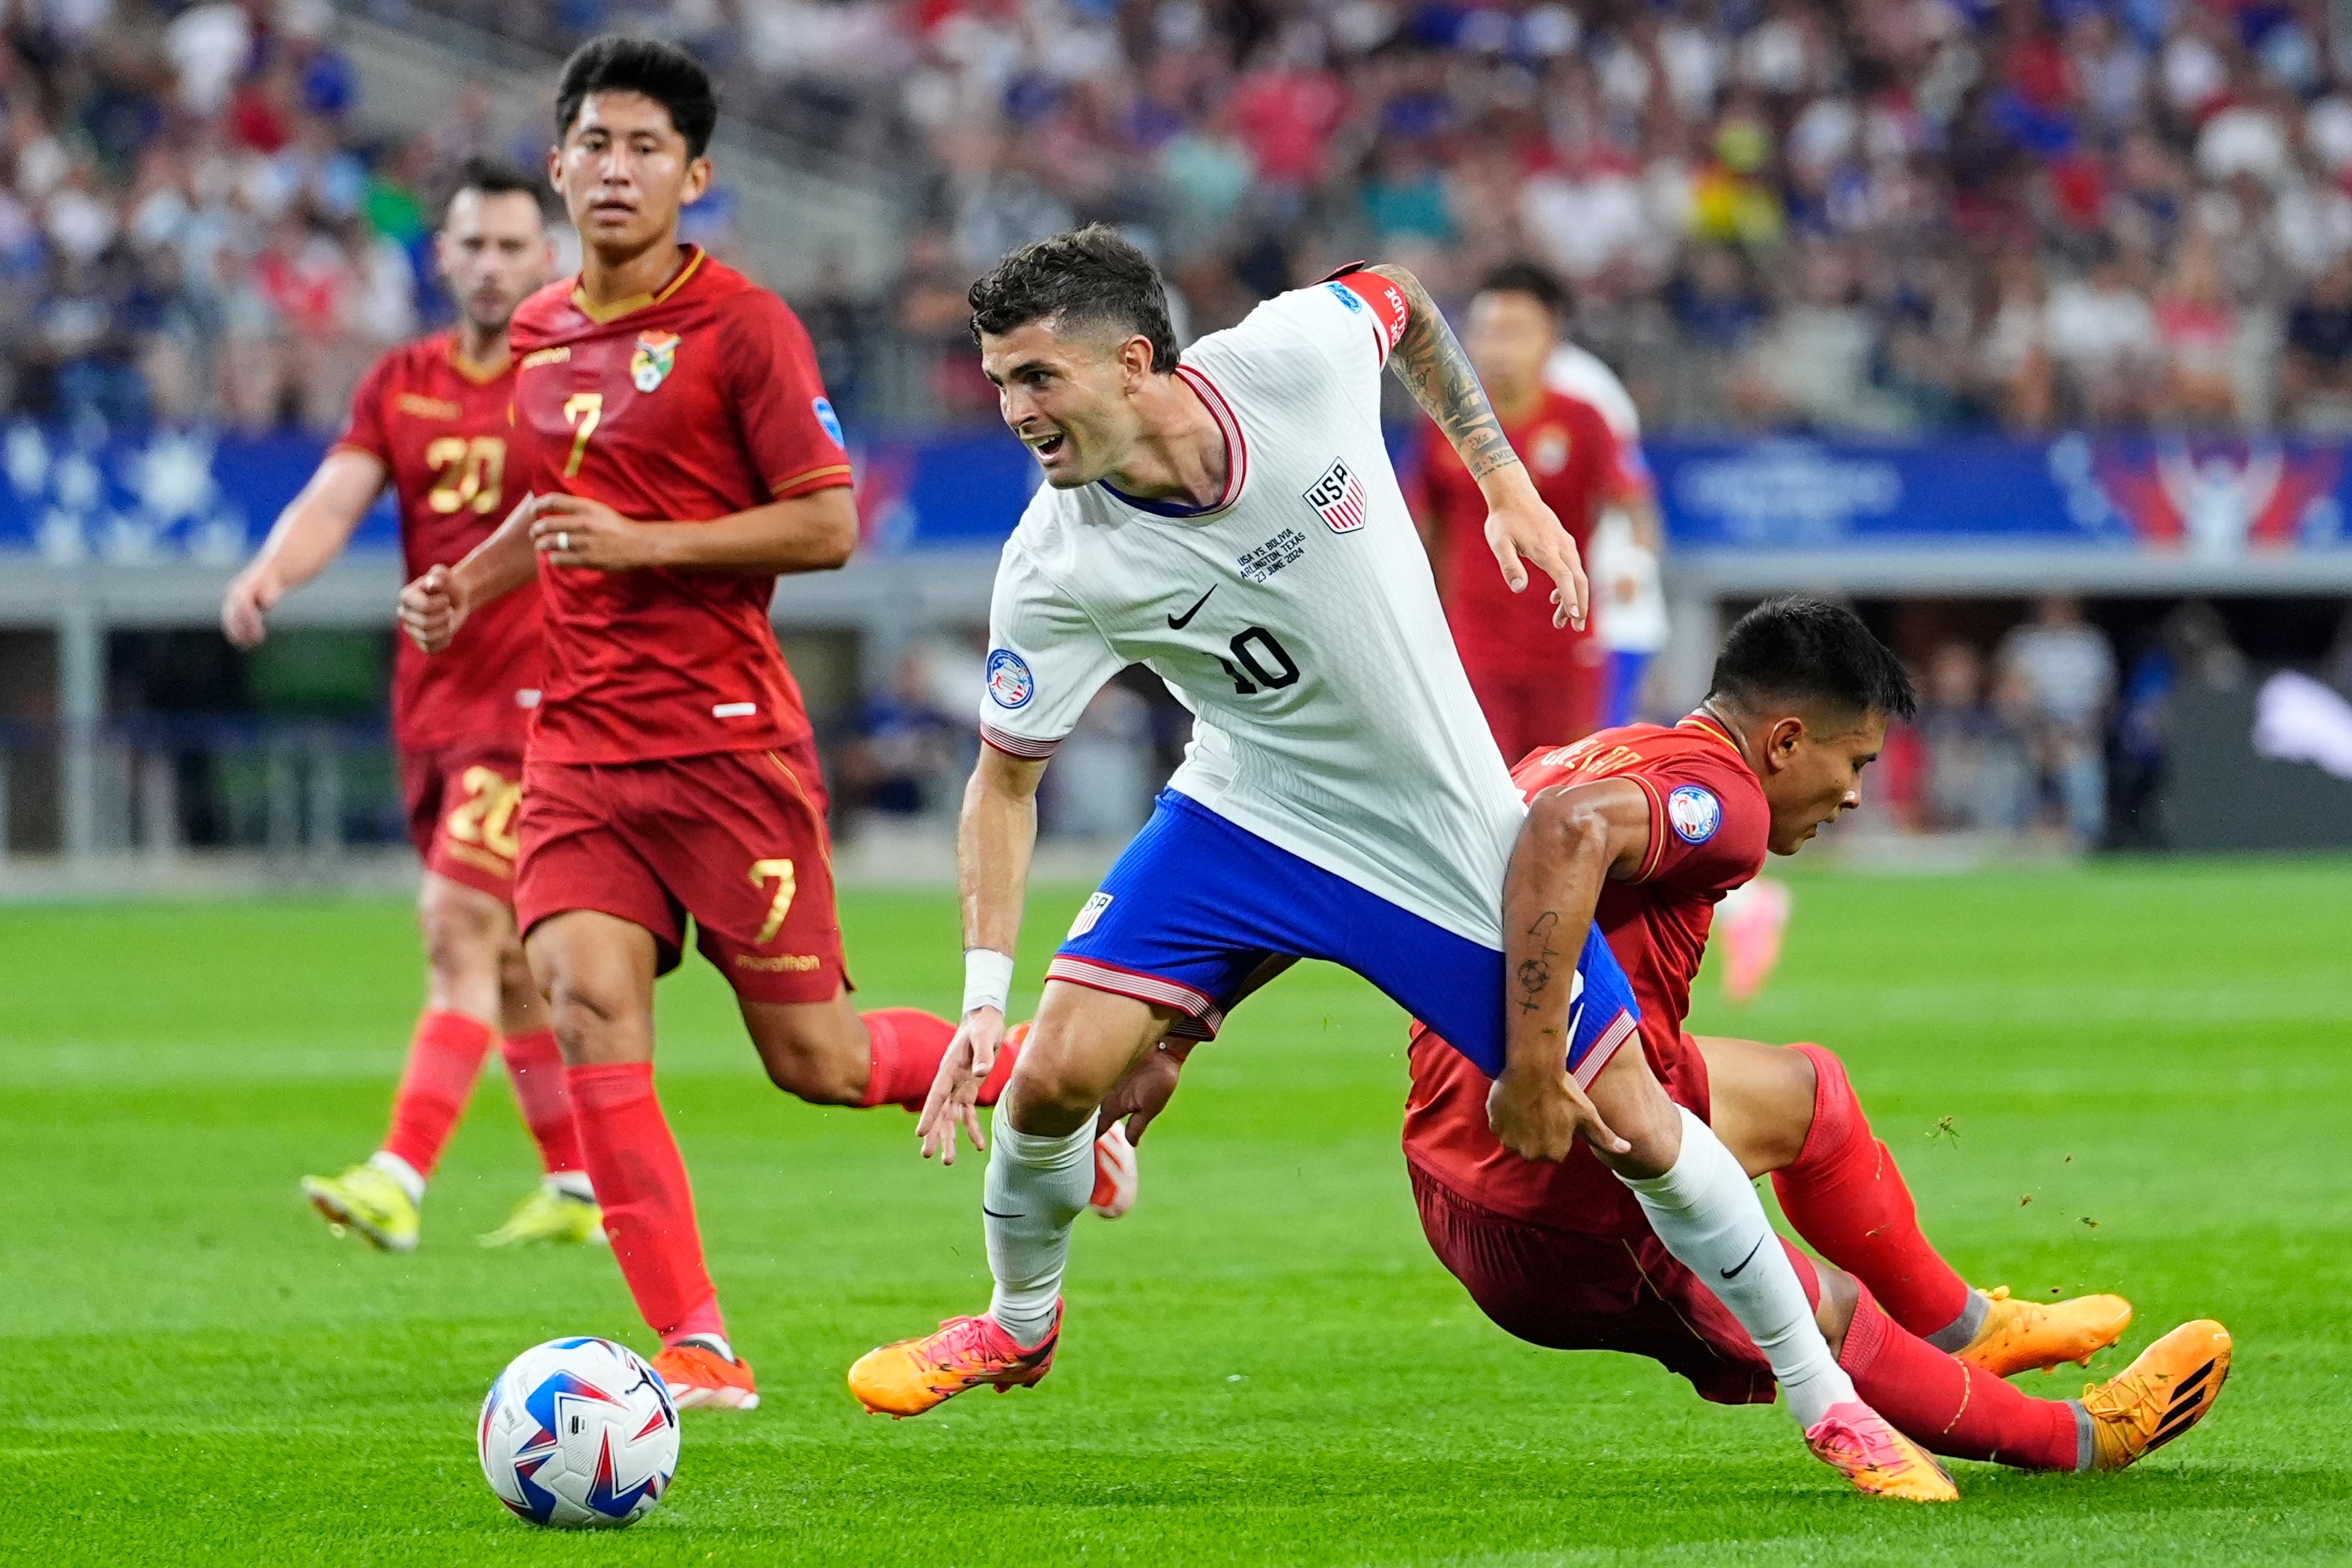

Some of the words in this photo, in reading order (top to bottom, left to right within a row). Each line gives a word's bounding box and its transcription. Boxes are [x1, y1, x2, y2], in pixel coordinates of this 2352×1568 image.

[564, 393, 603, 478] 7
[425, 436, 507, 514] 20
[1310, 463, 1348, 507] USA
[1237, 553, 1255, 567] USA
[1253, 546, 1267, 558] VS.
[1265, 528, 1294, 551] BOLIVIA
[1255, 570, 1267, 583] 23
[1267, 558, 1286, 576] JUNE
[1284, 547, 1305, 564] 2024
[1280, 532, 1306, 552] TEXAS
[1201, 626, 1300, 695] 10
[748, 858, 797, 945] 7
